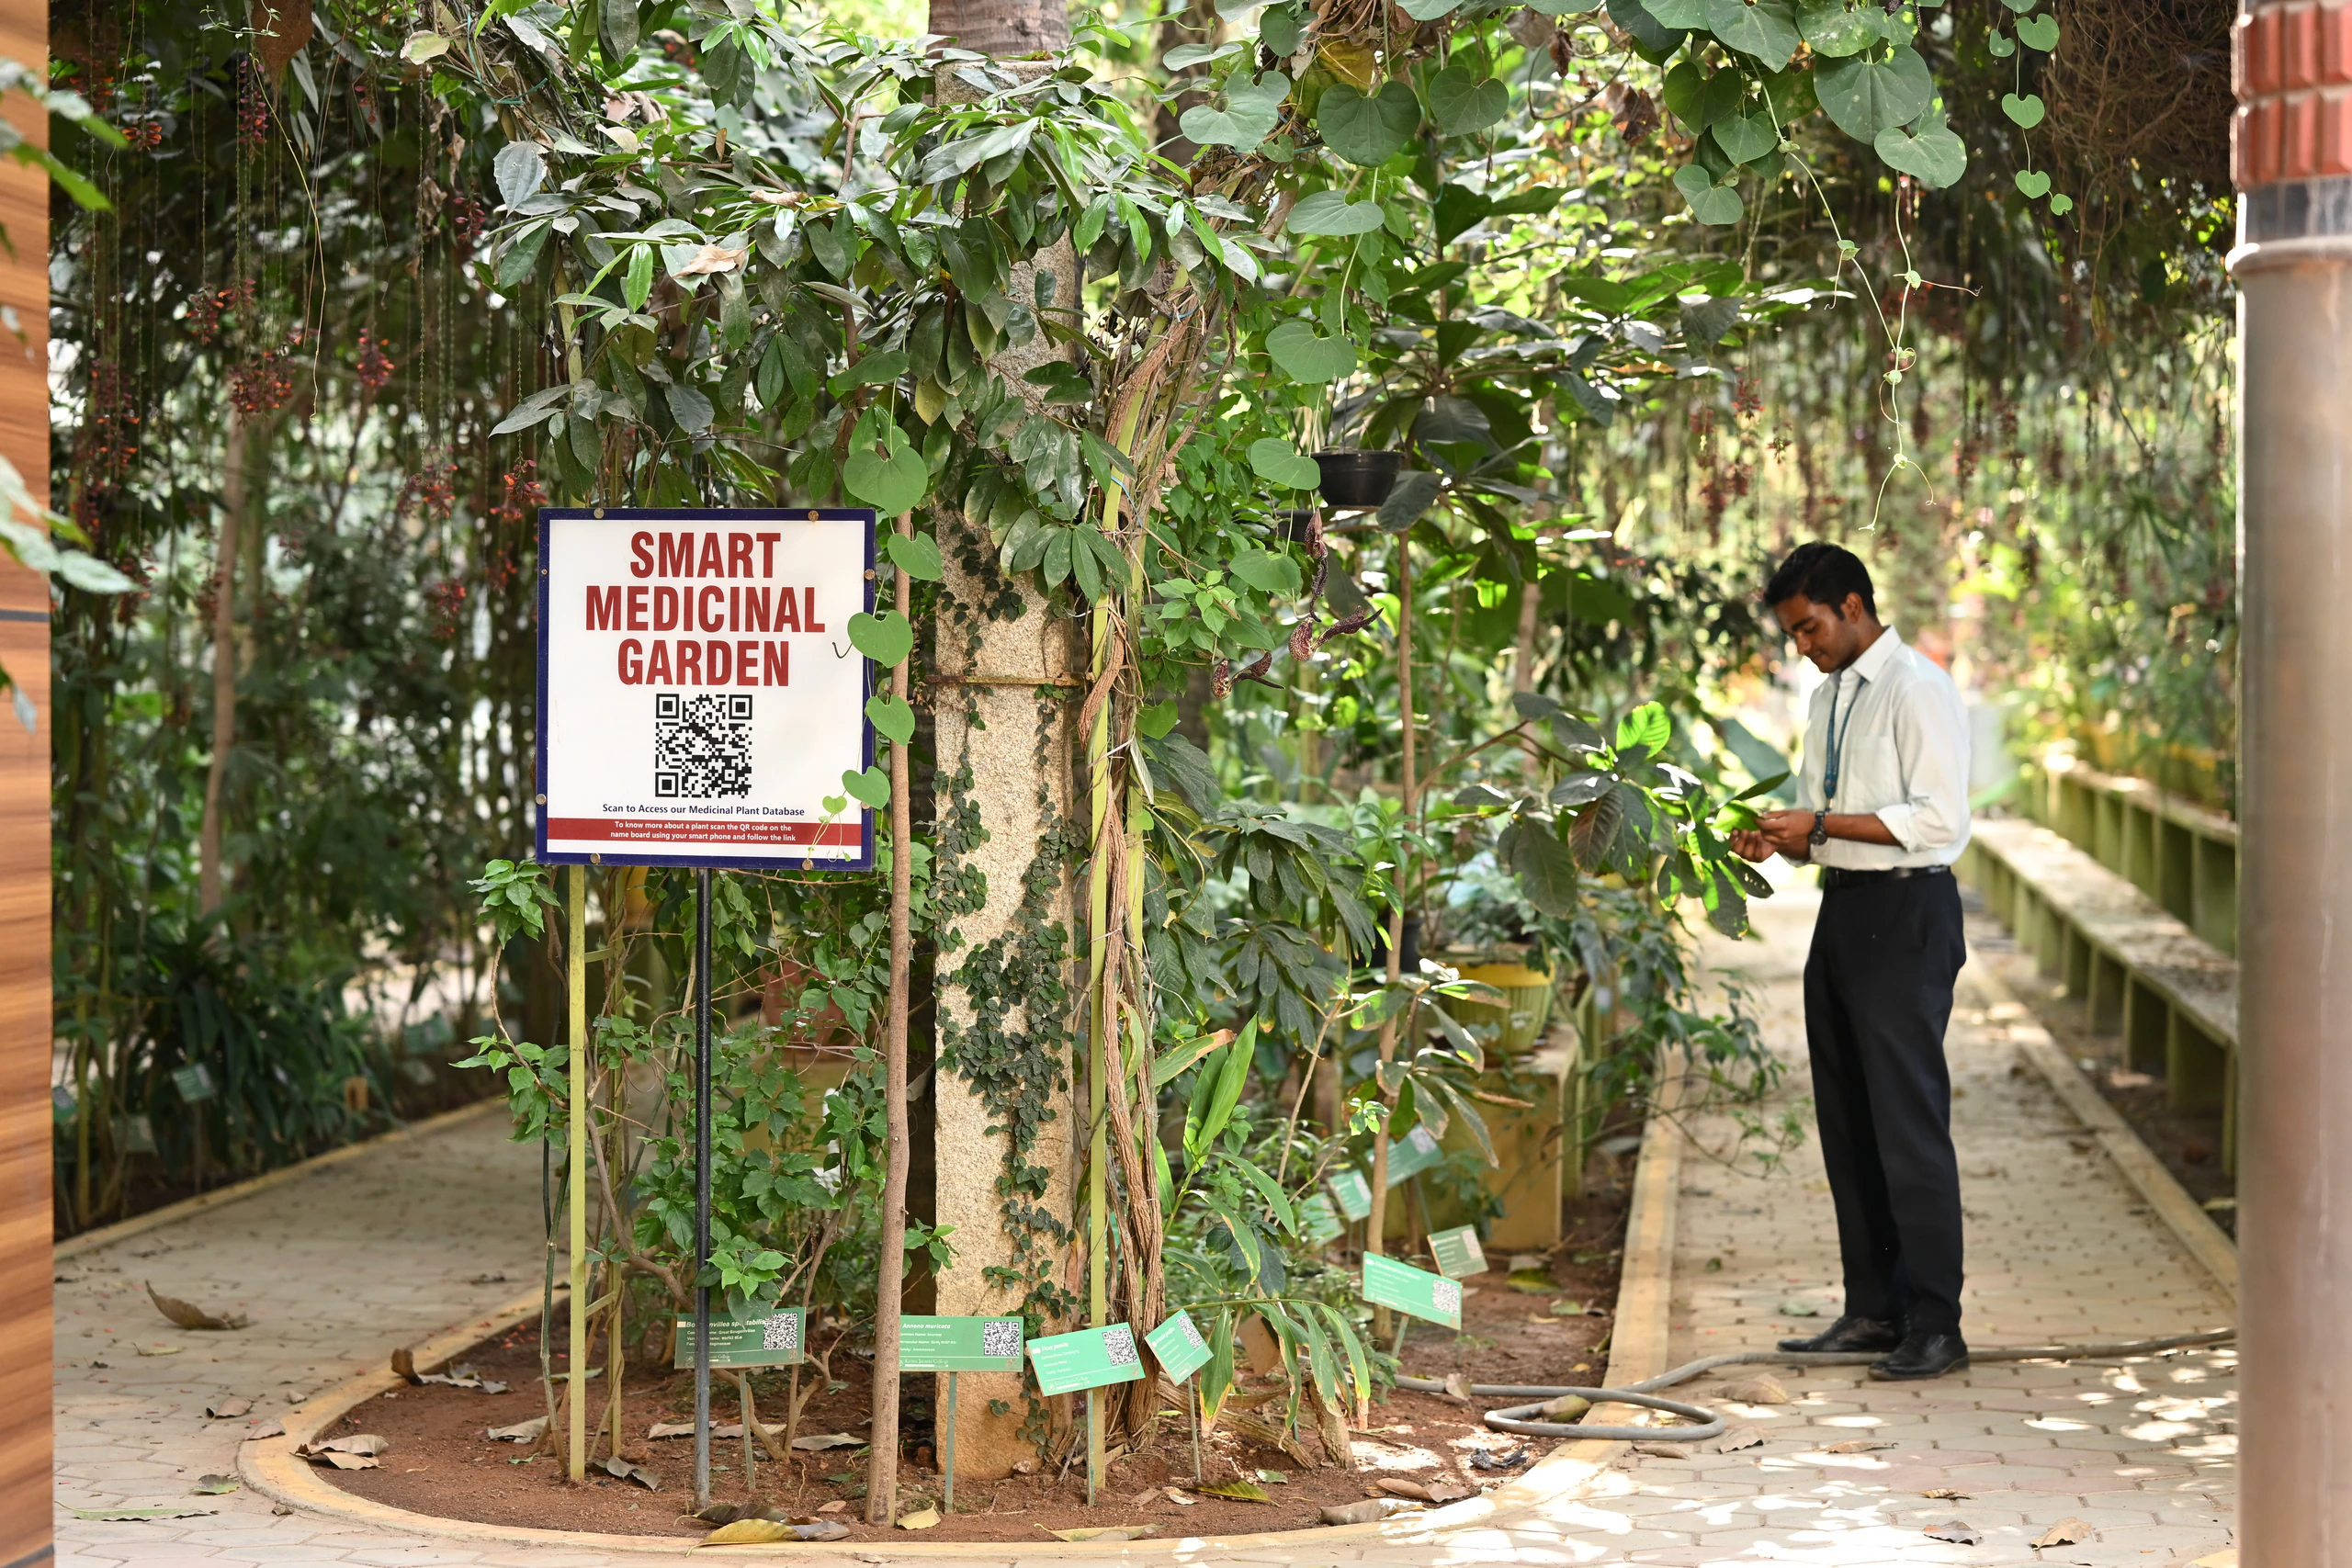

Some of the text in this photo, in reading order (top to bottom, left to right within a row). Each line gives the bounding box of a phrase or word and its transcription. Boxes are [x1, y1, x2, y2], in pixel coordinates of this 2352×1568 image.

[630, 531, 782, 579] SMART
[585, 585, 826, 634] MEDICINAL
[617, 637, 789, 687] GARDEN
[602, 804, 805, 817] Scan to Access our Medicinal Plant Database
[625, 820, 644, 829] know
[663, 821, 684, 829] about
[691, 822, 709, 831] plant
[739, 824, 751, 832] QR
[751, 823, 769, 831] code
[779, 824, 792, 832] the
[630, 830, 650, 839] board
[651, 831, 671, 840] using
[709, 832, 731, 841] phone
[746, 832, 769, 841] follow
[731, 1319, 765, 1327] sptabilis
